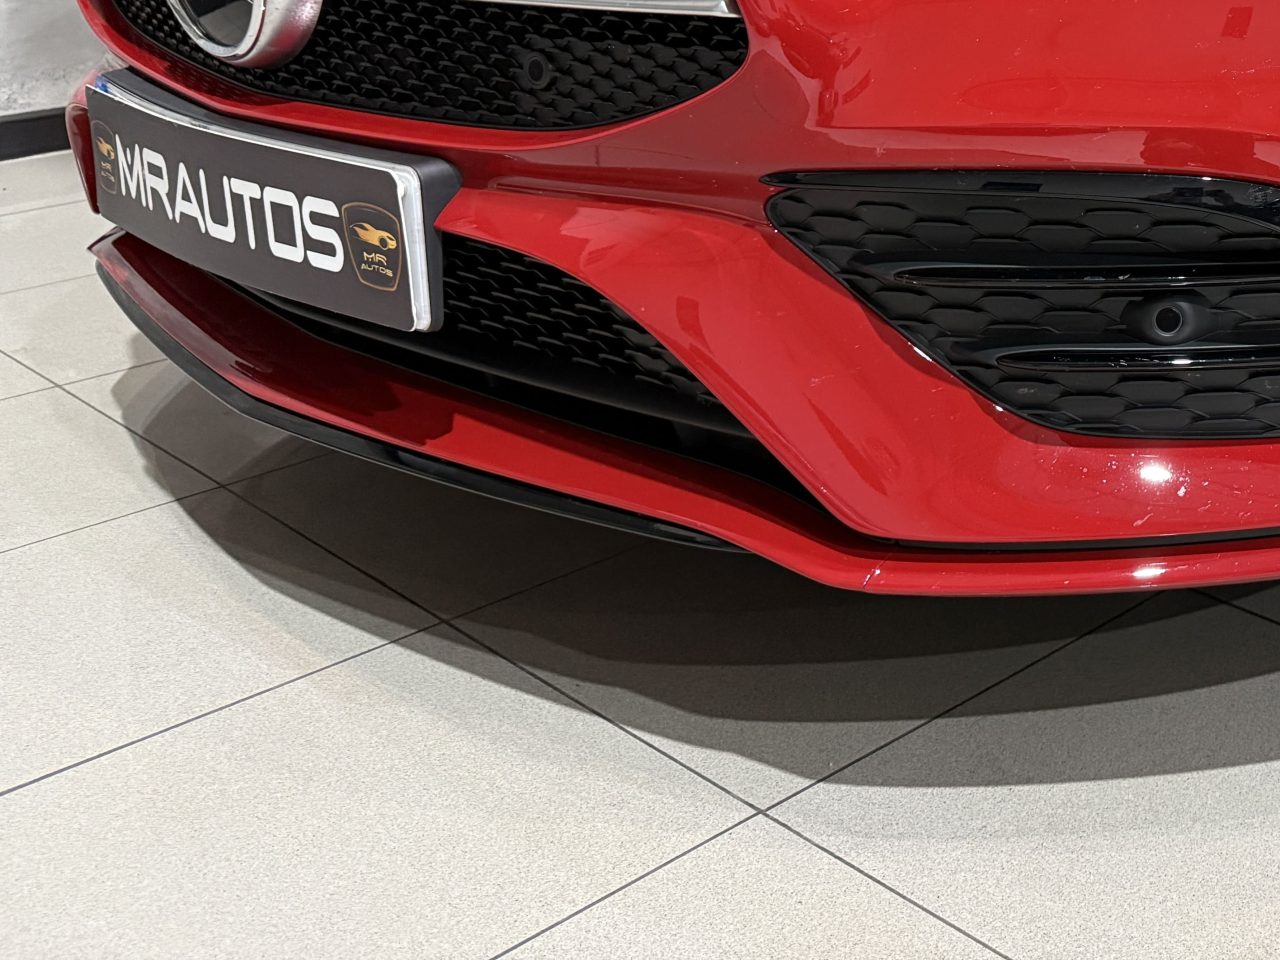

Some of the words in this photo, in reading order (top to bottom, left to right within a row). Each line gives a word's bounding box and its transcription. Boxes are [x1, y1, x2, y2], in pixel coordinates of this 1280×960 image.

[115, 133, 345, 273] MRAUTOS
[363, 251, 387, 266] MR
[361, 263, 393, 277] AUTOS
